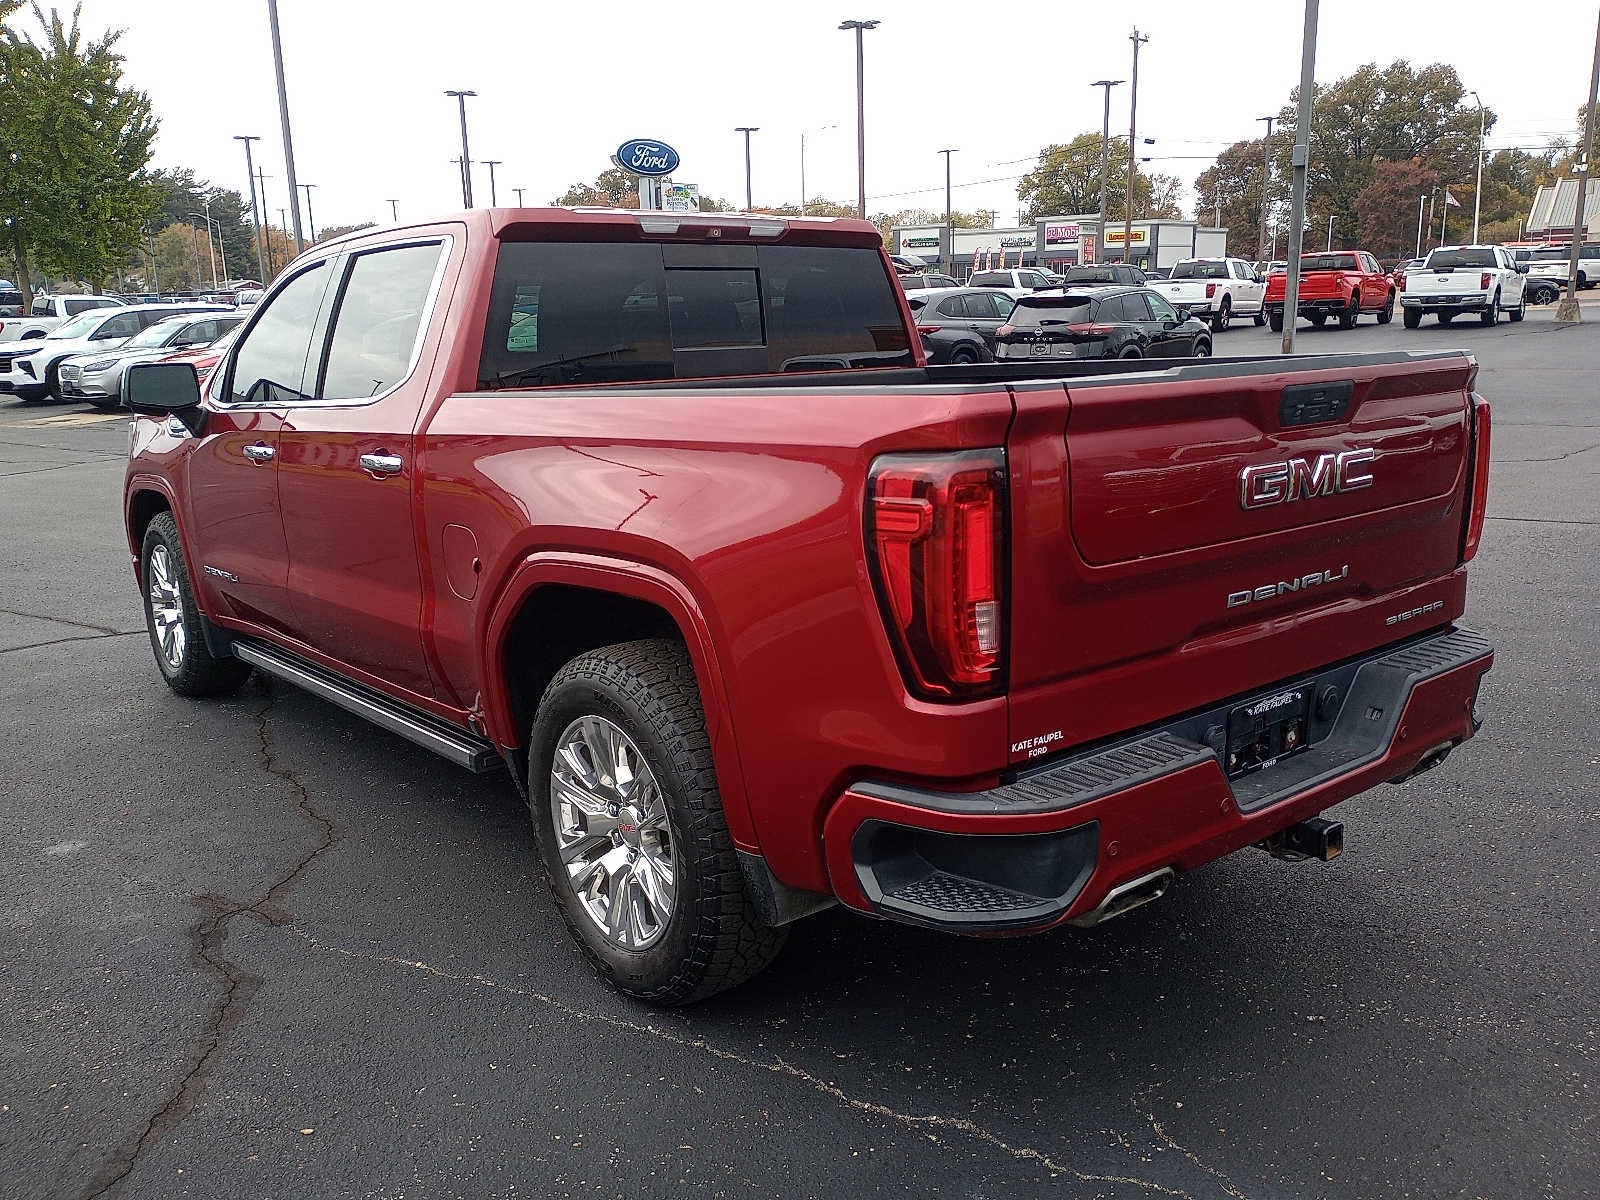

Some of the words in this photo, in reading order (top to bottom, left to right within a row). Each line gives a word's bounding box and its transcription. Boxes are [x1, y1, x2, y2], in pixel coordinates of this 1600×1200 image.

[631, 144, 669, 169] Ford
[1240, 447, 1375, 511] GMC
[1226, 564, 1349, 609] DENALI
[1385, 600, 1444, 626] SIERRA
[1011, 738, 1033, 753] KATE
[1033, 730, 1064, 747] FAUPEL
[1028, 746, 1048, 758] FORD
